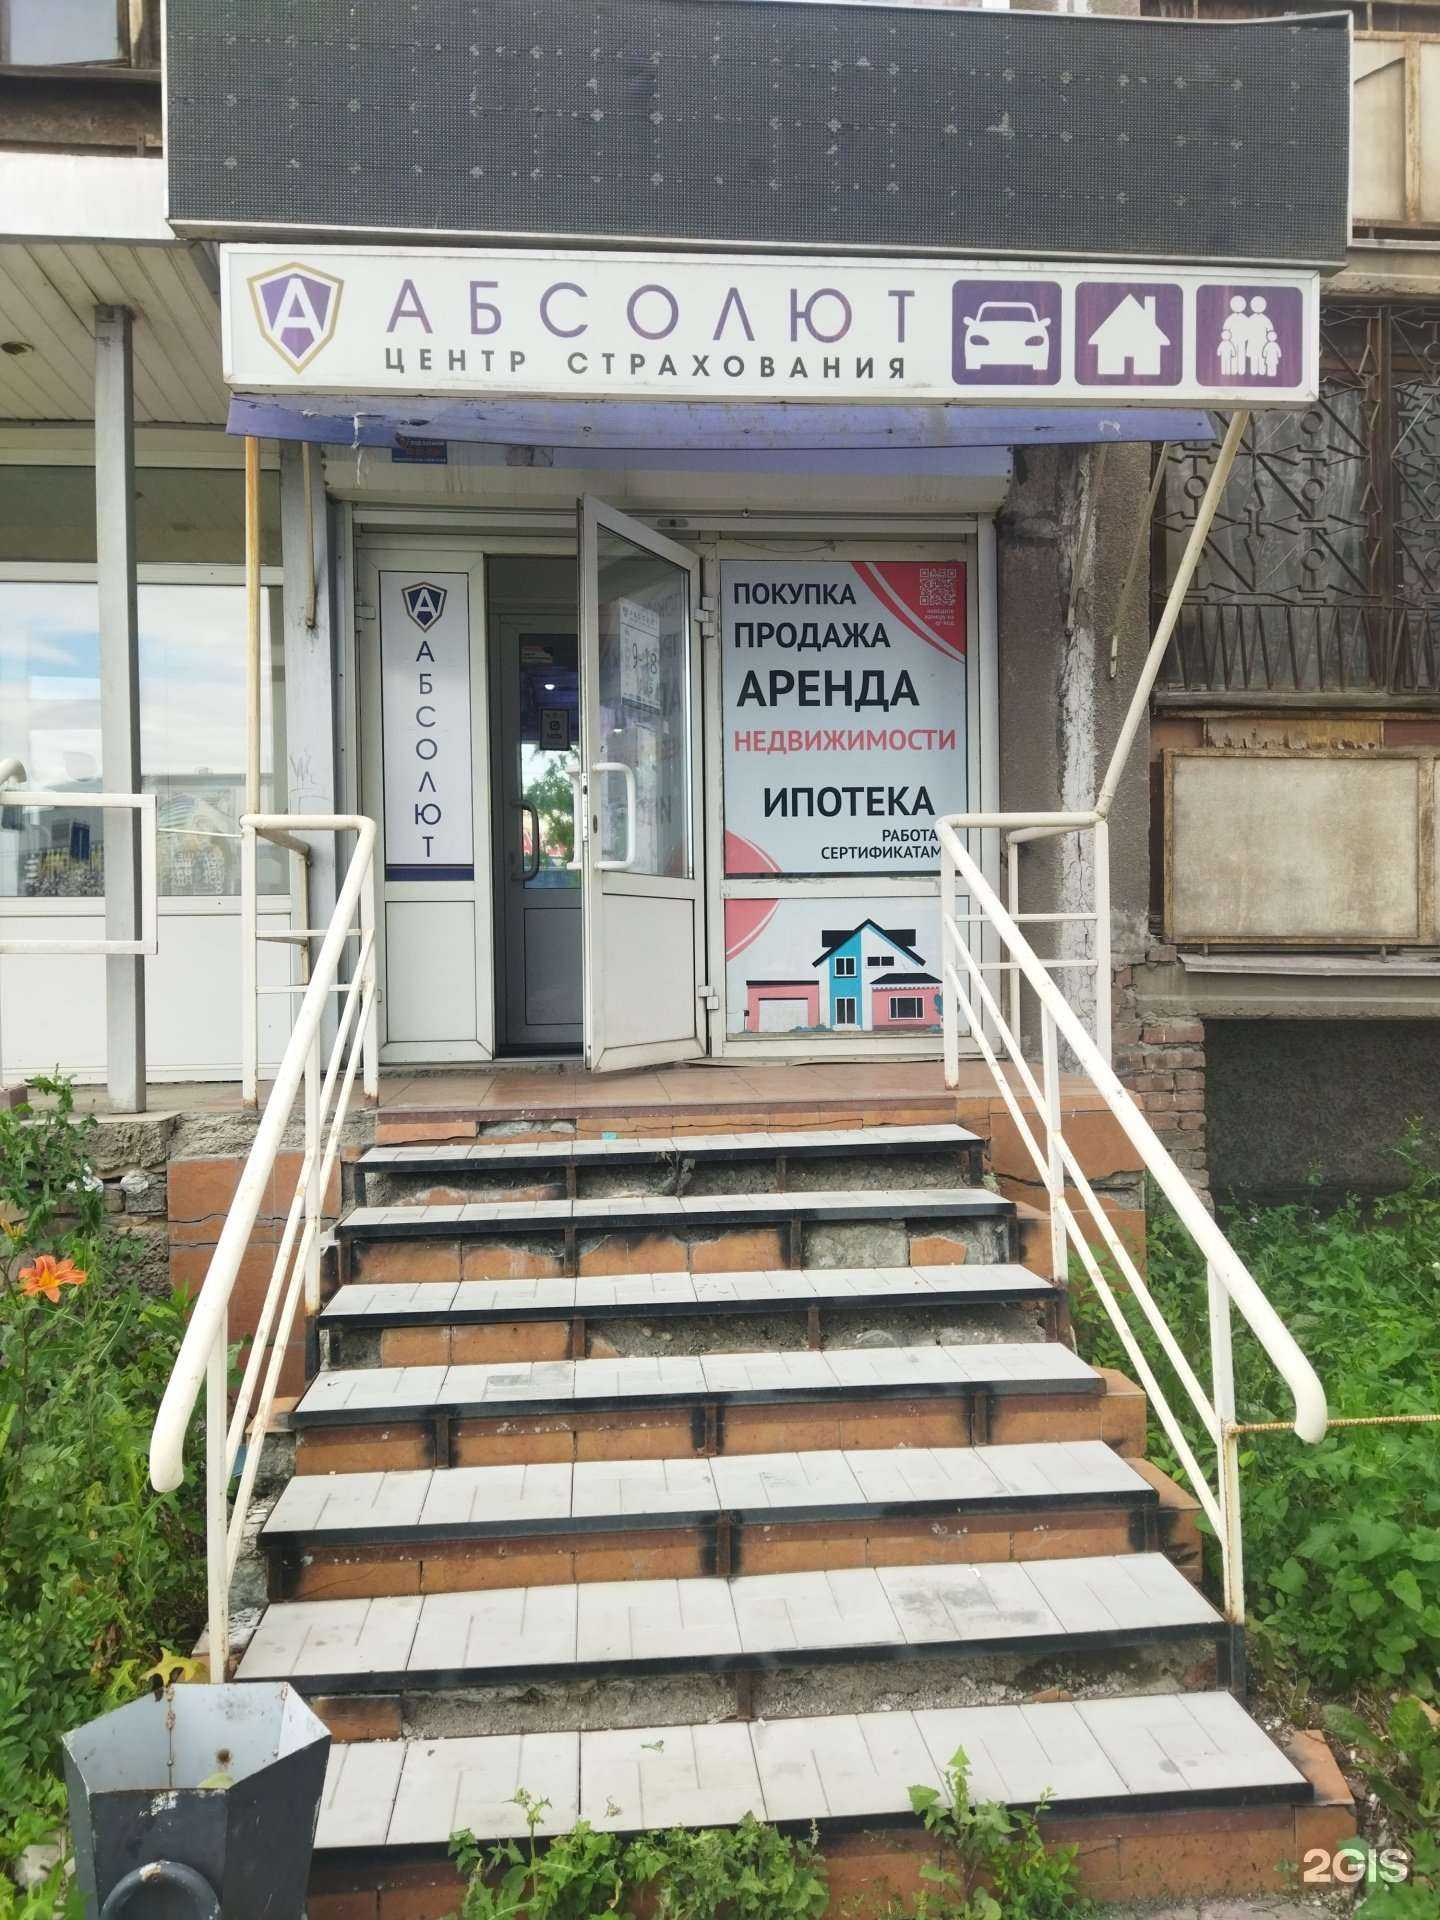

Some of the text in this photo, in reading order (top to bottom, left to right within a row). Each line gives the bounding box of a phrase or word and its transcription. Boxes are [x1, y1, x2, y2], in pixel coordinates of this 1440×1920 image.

[386, 279, 915, 344] АБСОЛЮТ
[385, 347, 906, 381] ЦЕНТР СТРАХОВАНИЯ
[733, 582, 856, 605] ПОКУПКА
[734, 622, 891, 652] ПРОДАЖА
[736, 669, 920, 713] АРЕНДА
[414, 640, 442, 859] АБСОЛЮТ
[734, 729, 956, 755] НЕДВИЖИМОСТИ
[764, 786, 935, 818] ИПОТЕКА
[882, 829, 939, 842] РАБОТА
[821, 845, 942, 860] СЕРТИФИКАТАМ
